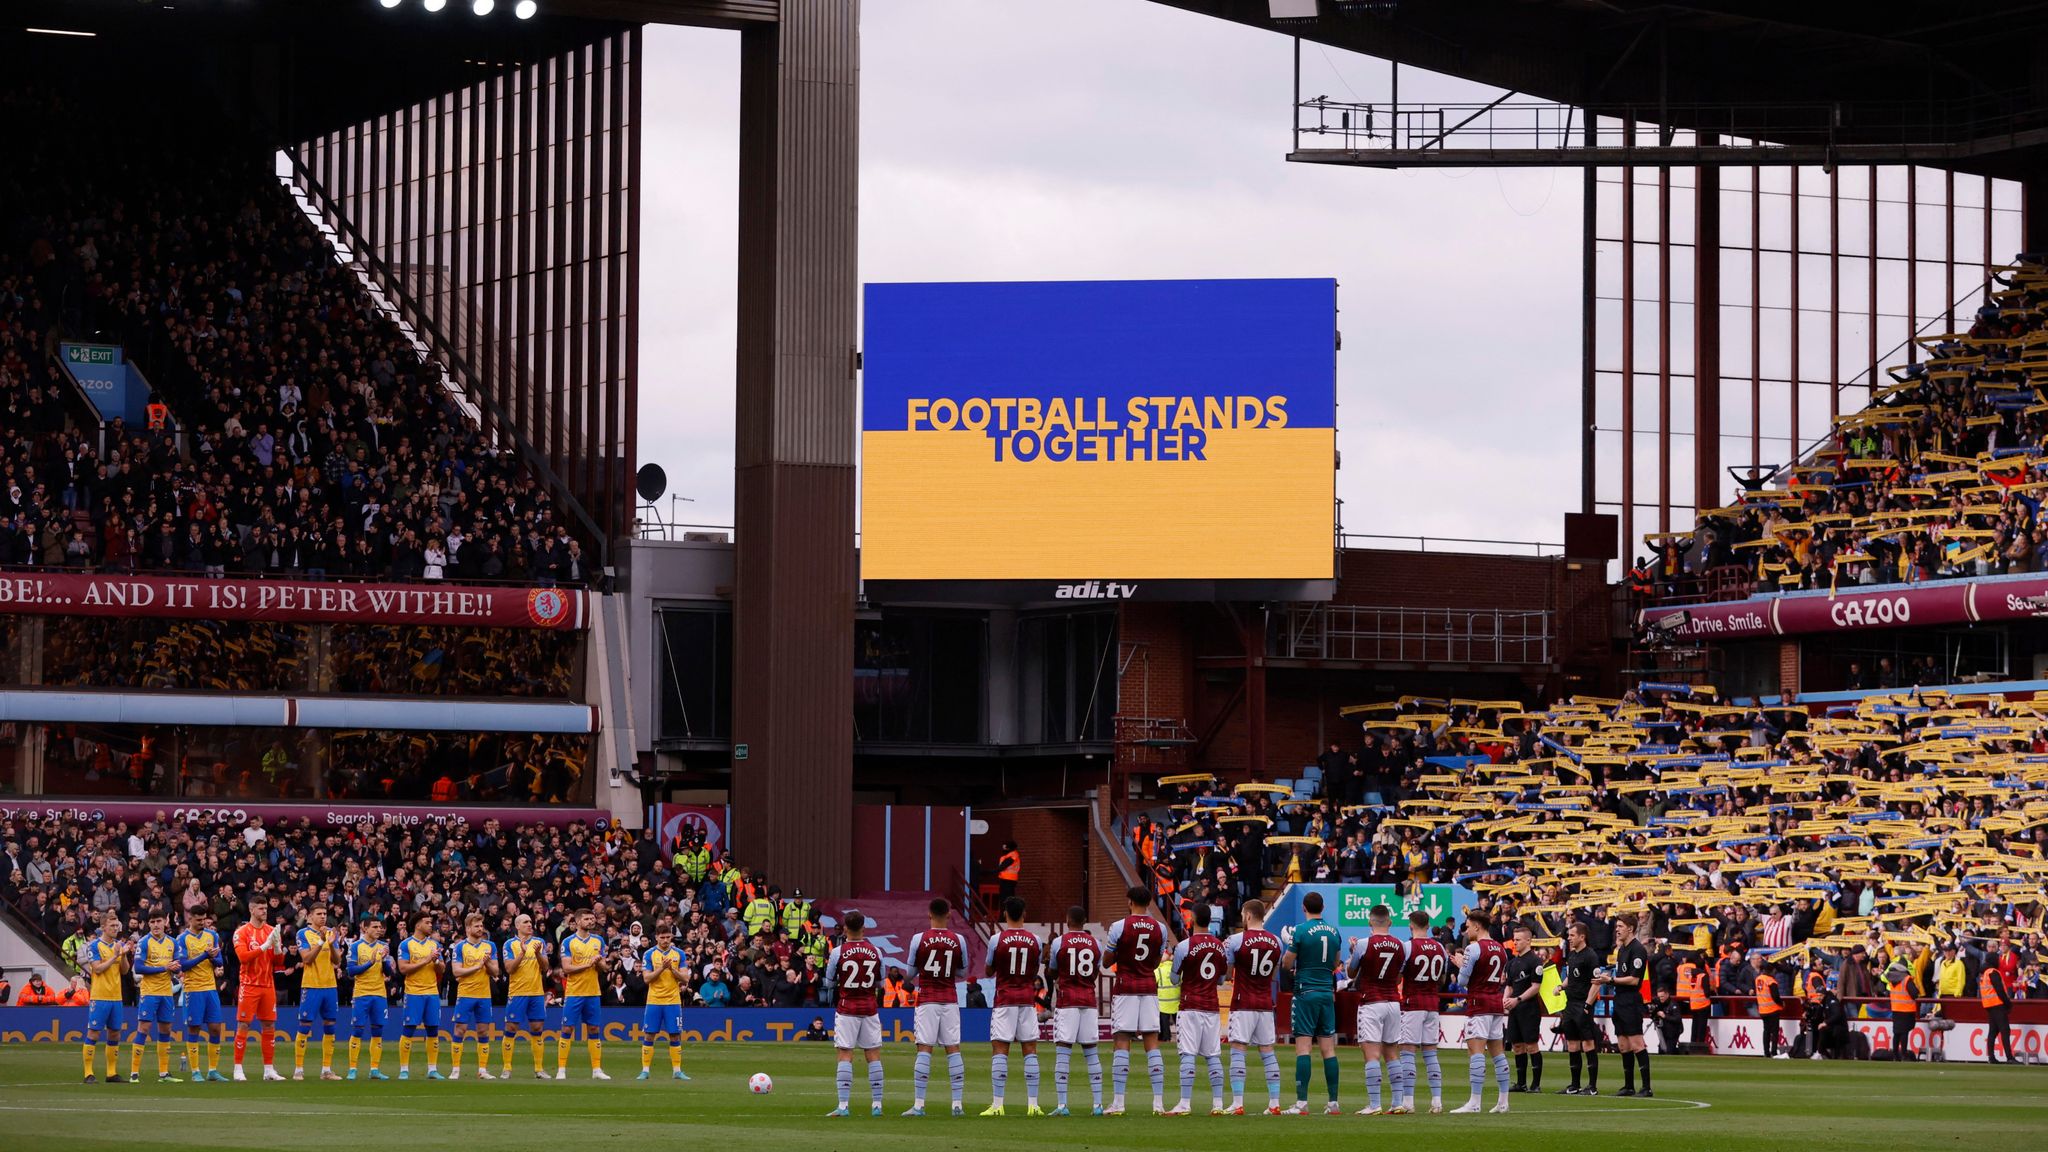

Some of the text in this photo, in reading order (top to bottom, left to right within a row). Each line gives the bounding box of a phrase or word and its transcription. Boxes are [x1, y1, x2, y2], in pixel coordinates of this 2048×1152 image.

[91, 351, 112, 361] EXIT
[907, 395, 1288, 431] FOOTBALL STANDS
[986, 428, 1208, 463] TOGETHER
[81, 581, 154, 606] AND
[165, 584, 199, 607] IT
[209, 585, 246, 609] IS!
[257, 586, 360, 612] PETER
[365, 589, 492, 616] WITHE!!
[1055, 580, 1138, 599] adi.tv
[1692, 617, 1727, 634] Drive.
[1728, 612, 1767, 631] Smile.
[1831, 597, 1910, 627] CAZOO
[1, 808, 40, 820] Drie.
[327, 812, 378, 824] Search.
[1345, 894, 1371, 906] Fire
[1132, 921, 1155, 931] MINGS
[1345, 908, 1370, 920] exit
[1002, 935, 1035, 946] WATKINS
[1067, 938, 1093, 947] YOUNG
[1134, 933, 1150, 961] 5
[1189, 942, 1216, 957] DOUGLAS
[1244, 936, 1278, 948] CHAMBERS
[1320, 935, 1328, 963] 1
[1421, 943, 1437, 951] INGS
[842, 947, 877, 960] COUTINHO
[923, 949, 953, 978] 41
[1008, 946, 1029, 975] 11
[1067, 947, 1095, 977] 18
[1200, 952, 1216, 980] 6
[1250, 948, 1274, 976] 16
[1378, 952, 1395, 979] 7
[842, 960, 877, 989] 23
[1414, 954, 1445, 982] 20
[1487, 955, 1501, 982] 2
[603, 1019, 754, 1042] Stnds
